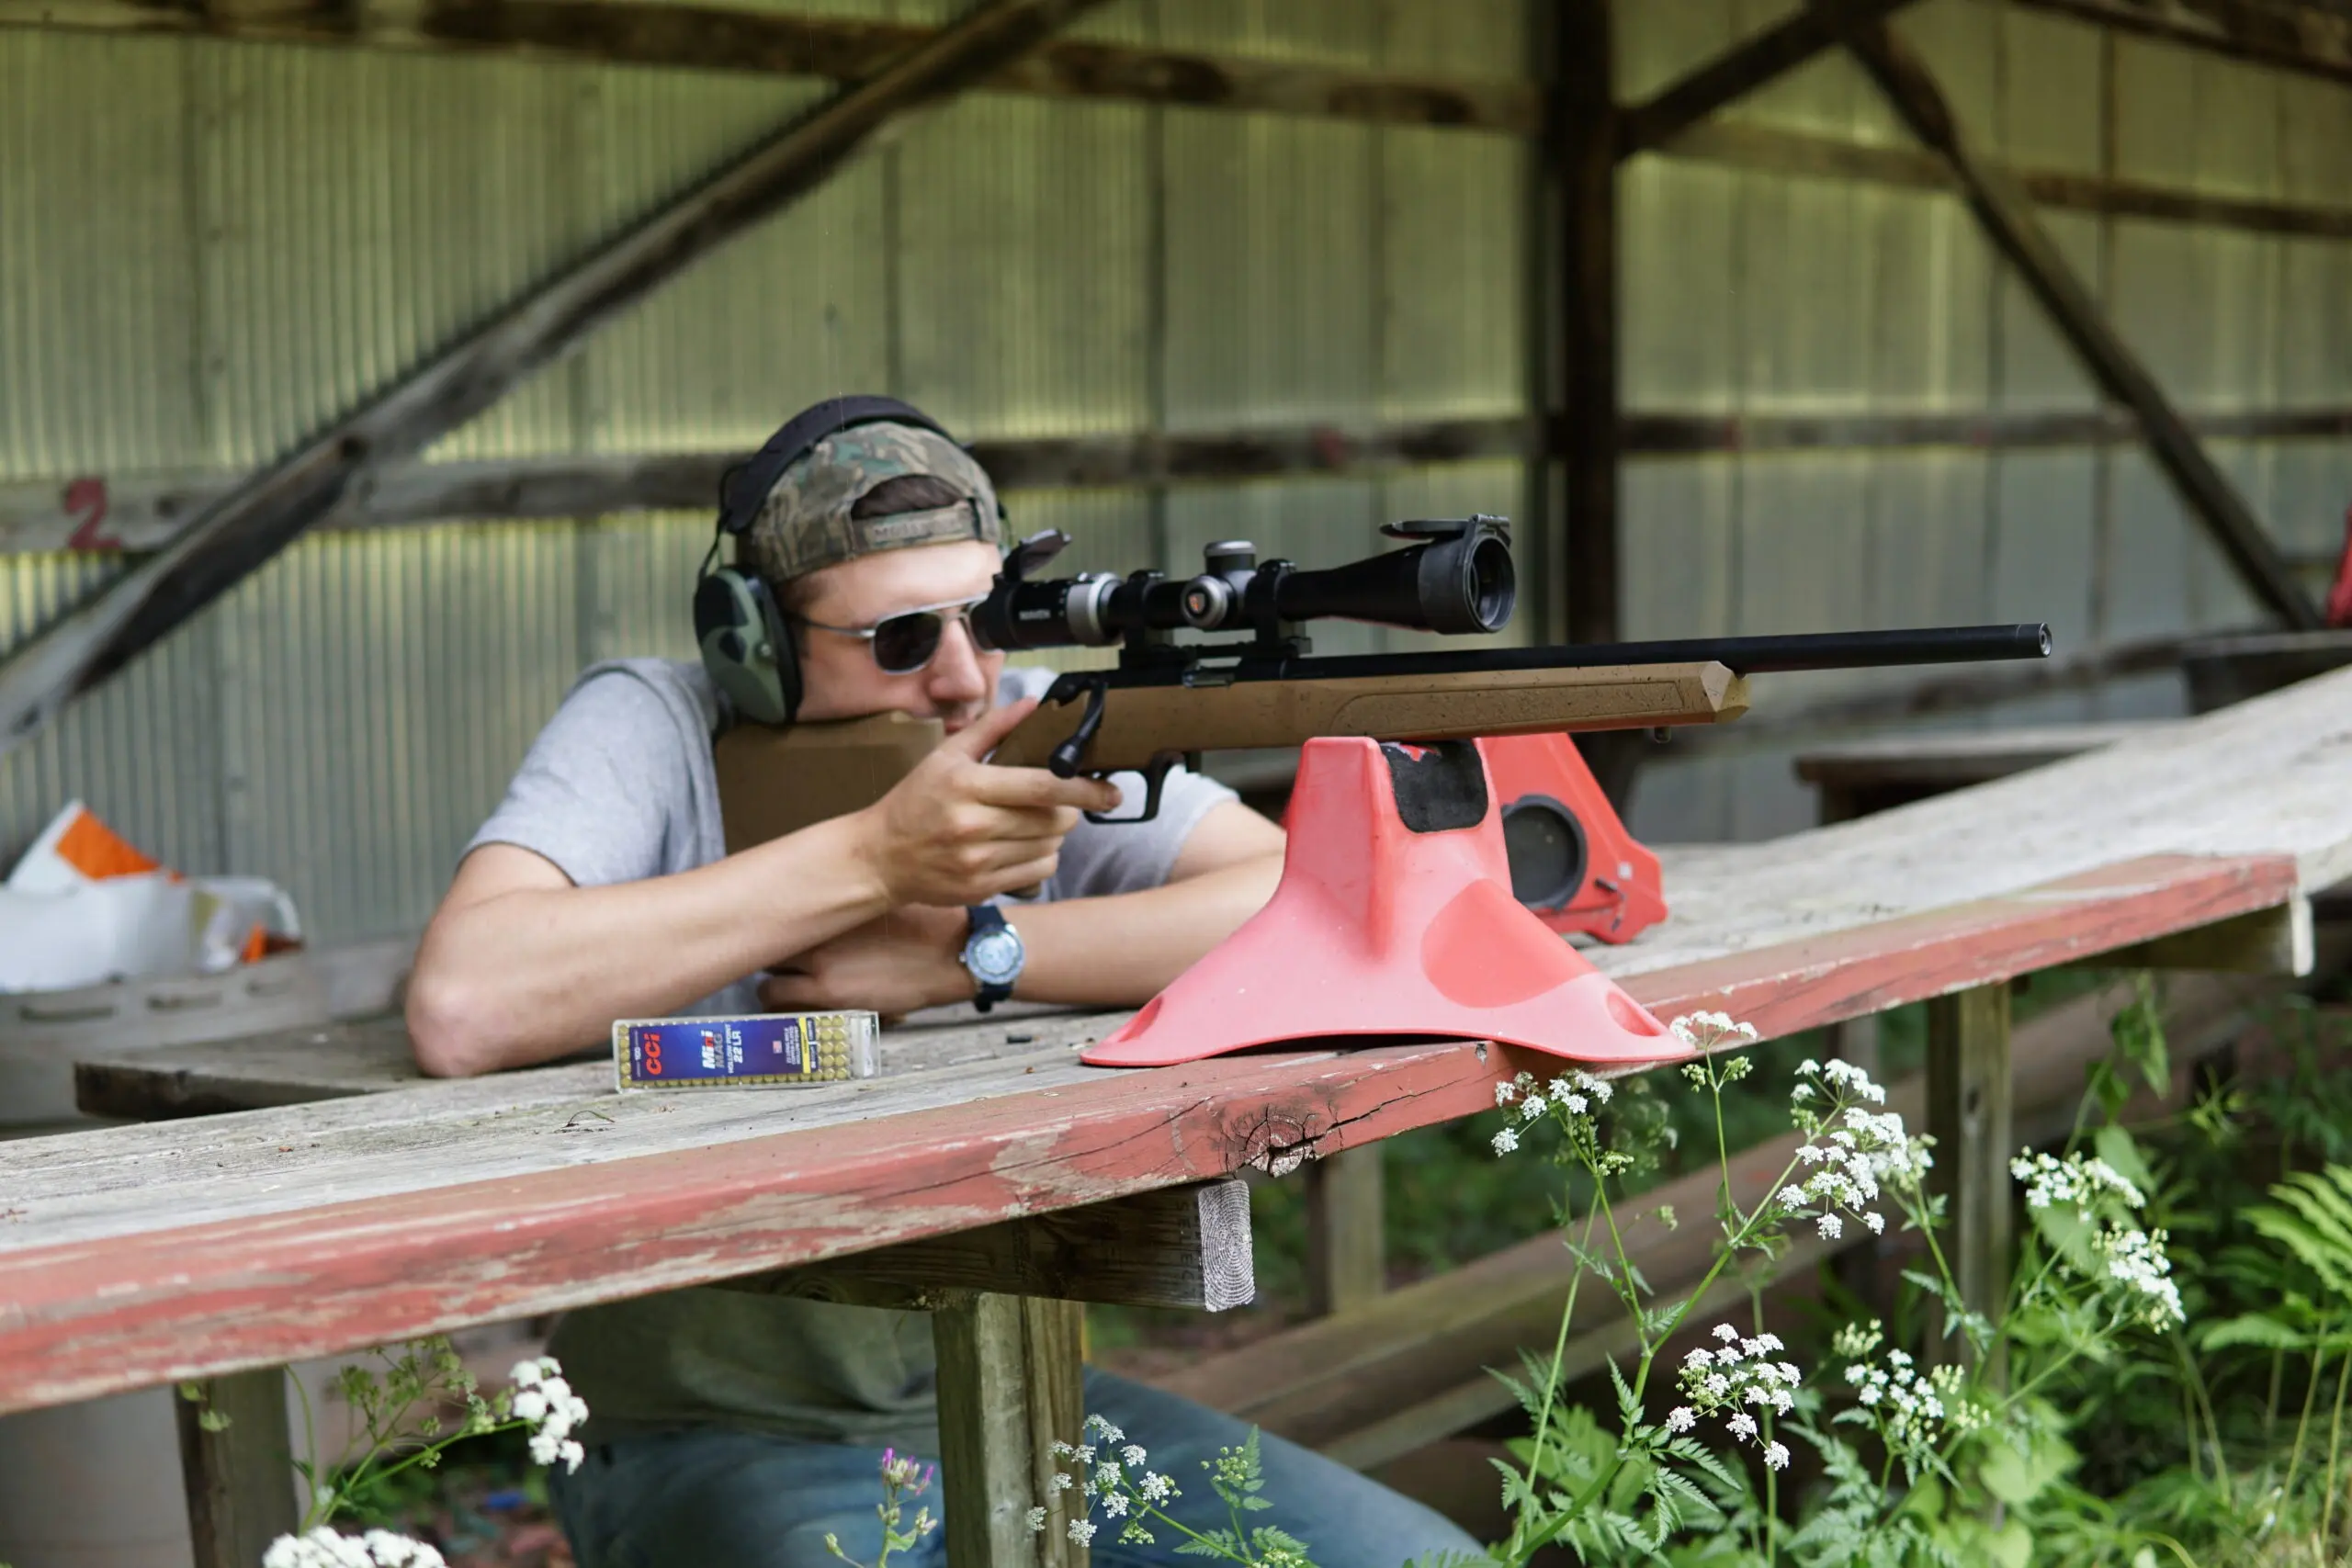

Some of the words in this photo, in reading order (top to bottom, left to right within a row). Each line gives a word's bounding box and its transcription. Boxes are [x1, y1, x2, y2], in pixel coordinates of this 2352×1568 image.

[64, 476, 120, 550] 2
[714, 1033, 725, 1067] MAG
[732, 1031, 741, 1045] LR
[734, 1047, 743, 1064] 22
